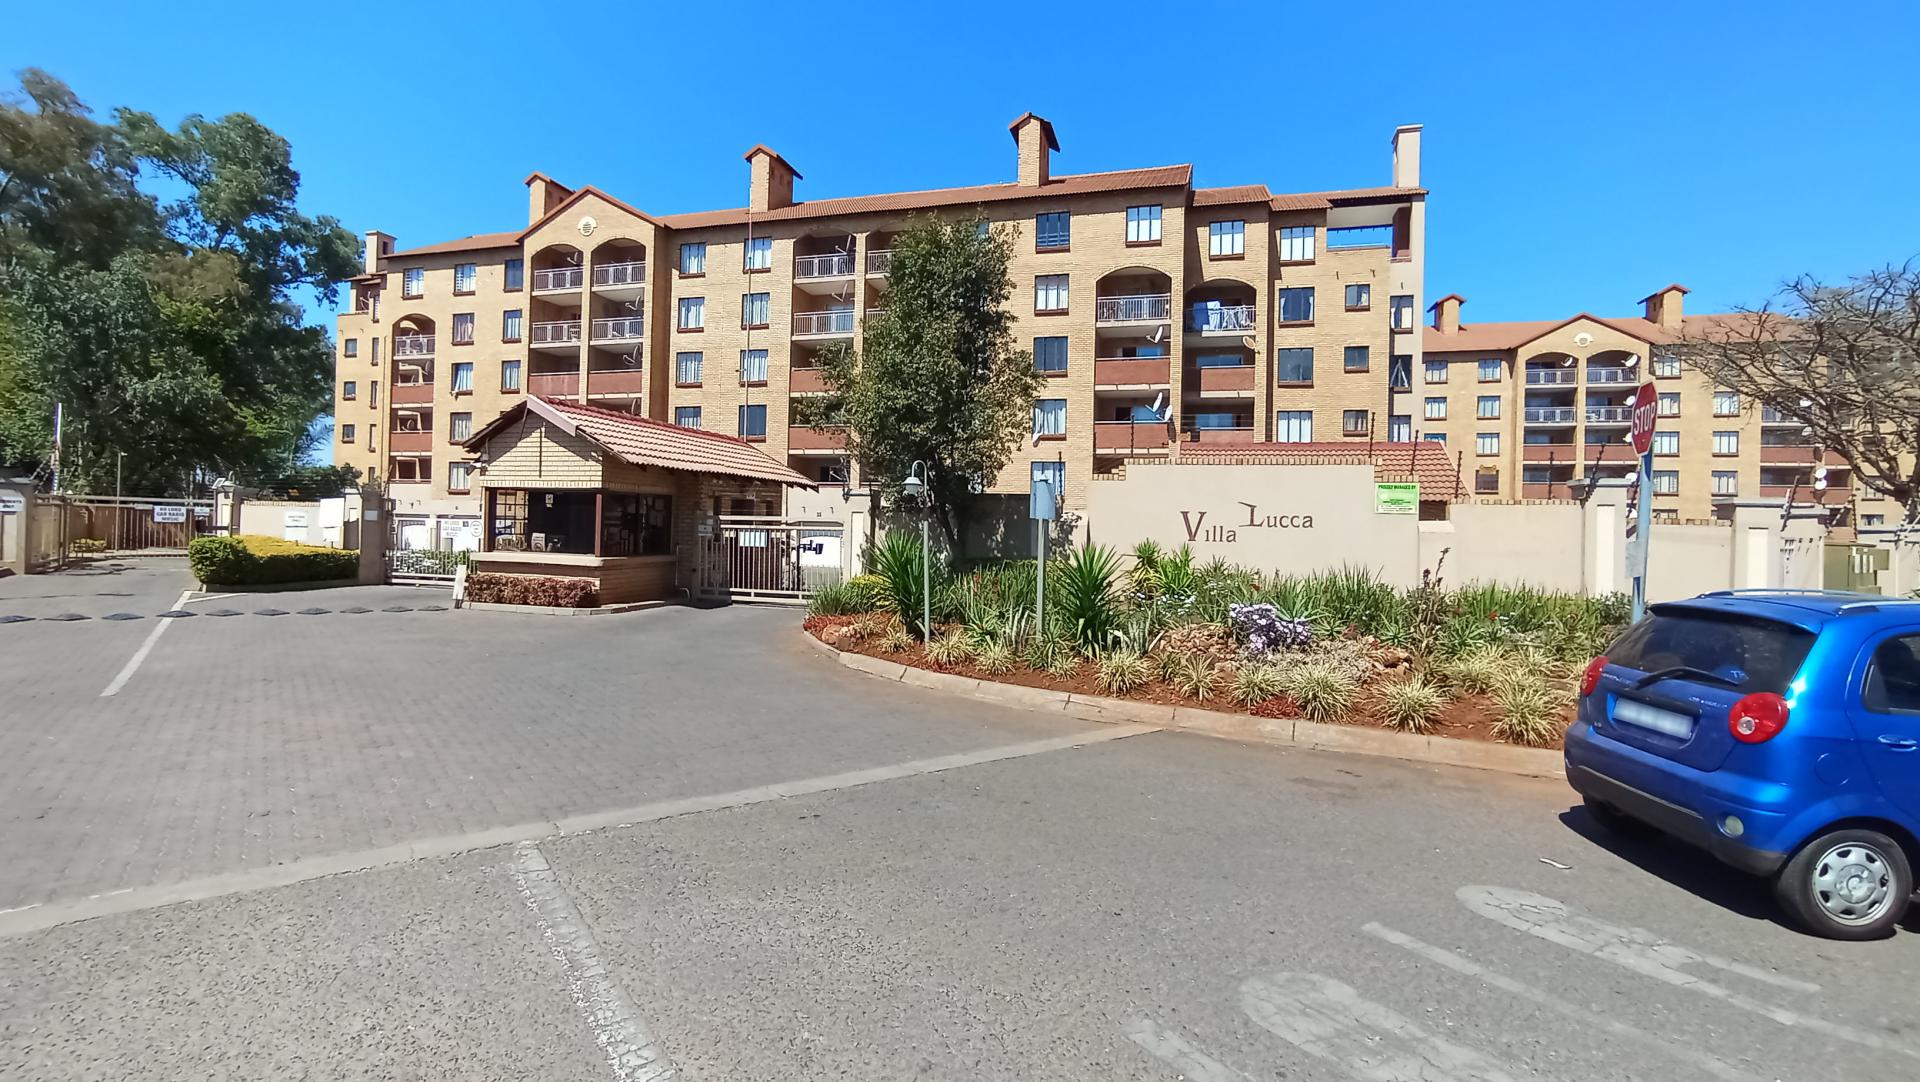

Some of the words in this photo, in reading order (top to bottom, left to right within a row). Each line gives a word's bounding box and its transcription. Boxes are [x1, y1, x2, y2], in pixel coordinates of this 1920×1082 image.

[1634, 402, 1655, 435] STOP
[1180, 510, 1237, 542] Villa
[1237, 500, 1314, 528] Lucca
